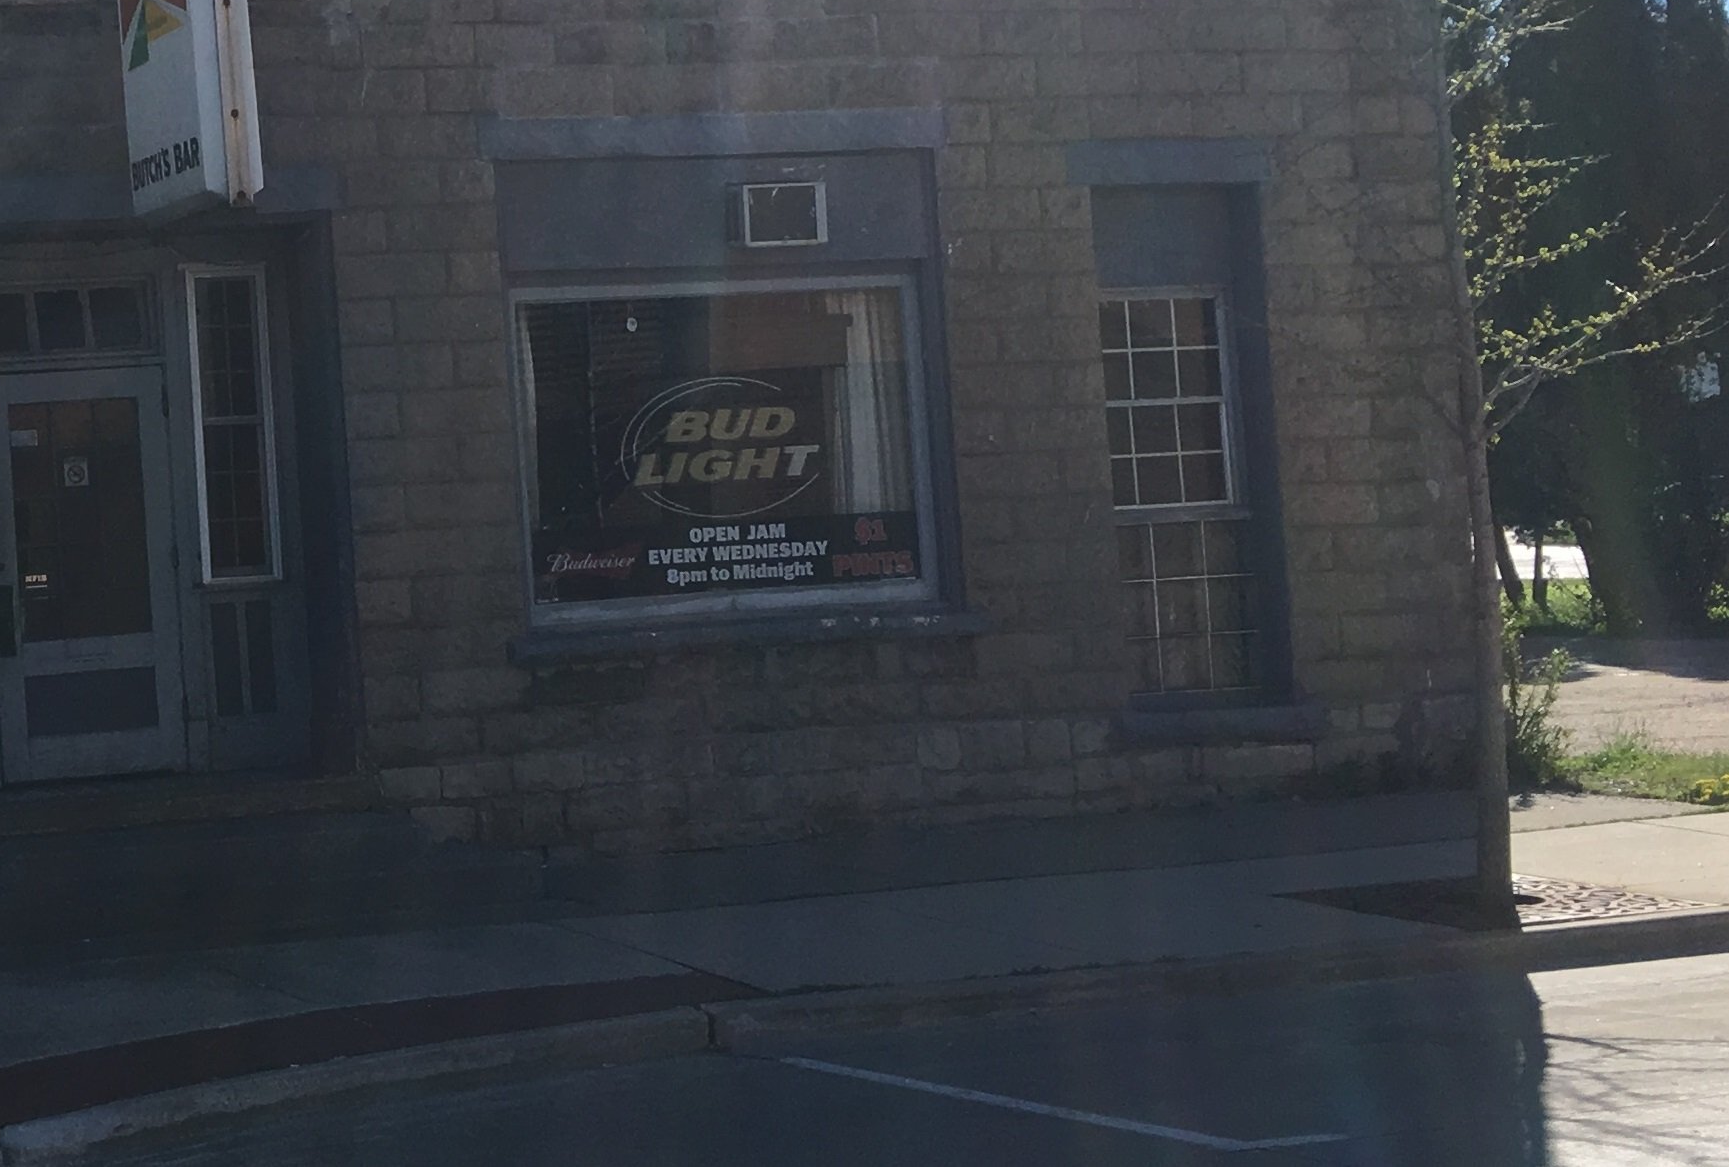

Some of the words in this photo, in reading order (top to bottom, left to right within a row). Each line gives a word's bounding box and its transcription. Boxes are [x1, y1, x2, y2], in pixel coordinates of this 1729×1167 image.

[132, 146, 171, 191] BUTCH'S
[173, 136, 200, 174] BAR
[664, 407, 797, 443] BUD
[634, 444, 820, 486] LIGHT
[689, 525, 740, 543] OPEN
[746, 523, 786, 540] JAM
[547, 552, 635, 573] Budweiser
[648, 547, 707, 565] EVERY
[712, 540, 828, 561] WEDNESDAY
[666, 567, 707, 586] 8pm
[710, 565, 729, 581] to
[733, 561, 814, 582] Midnight
